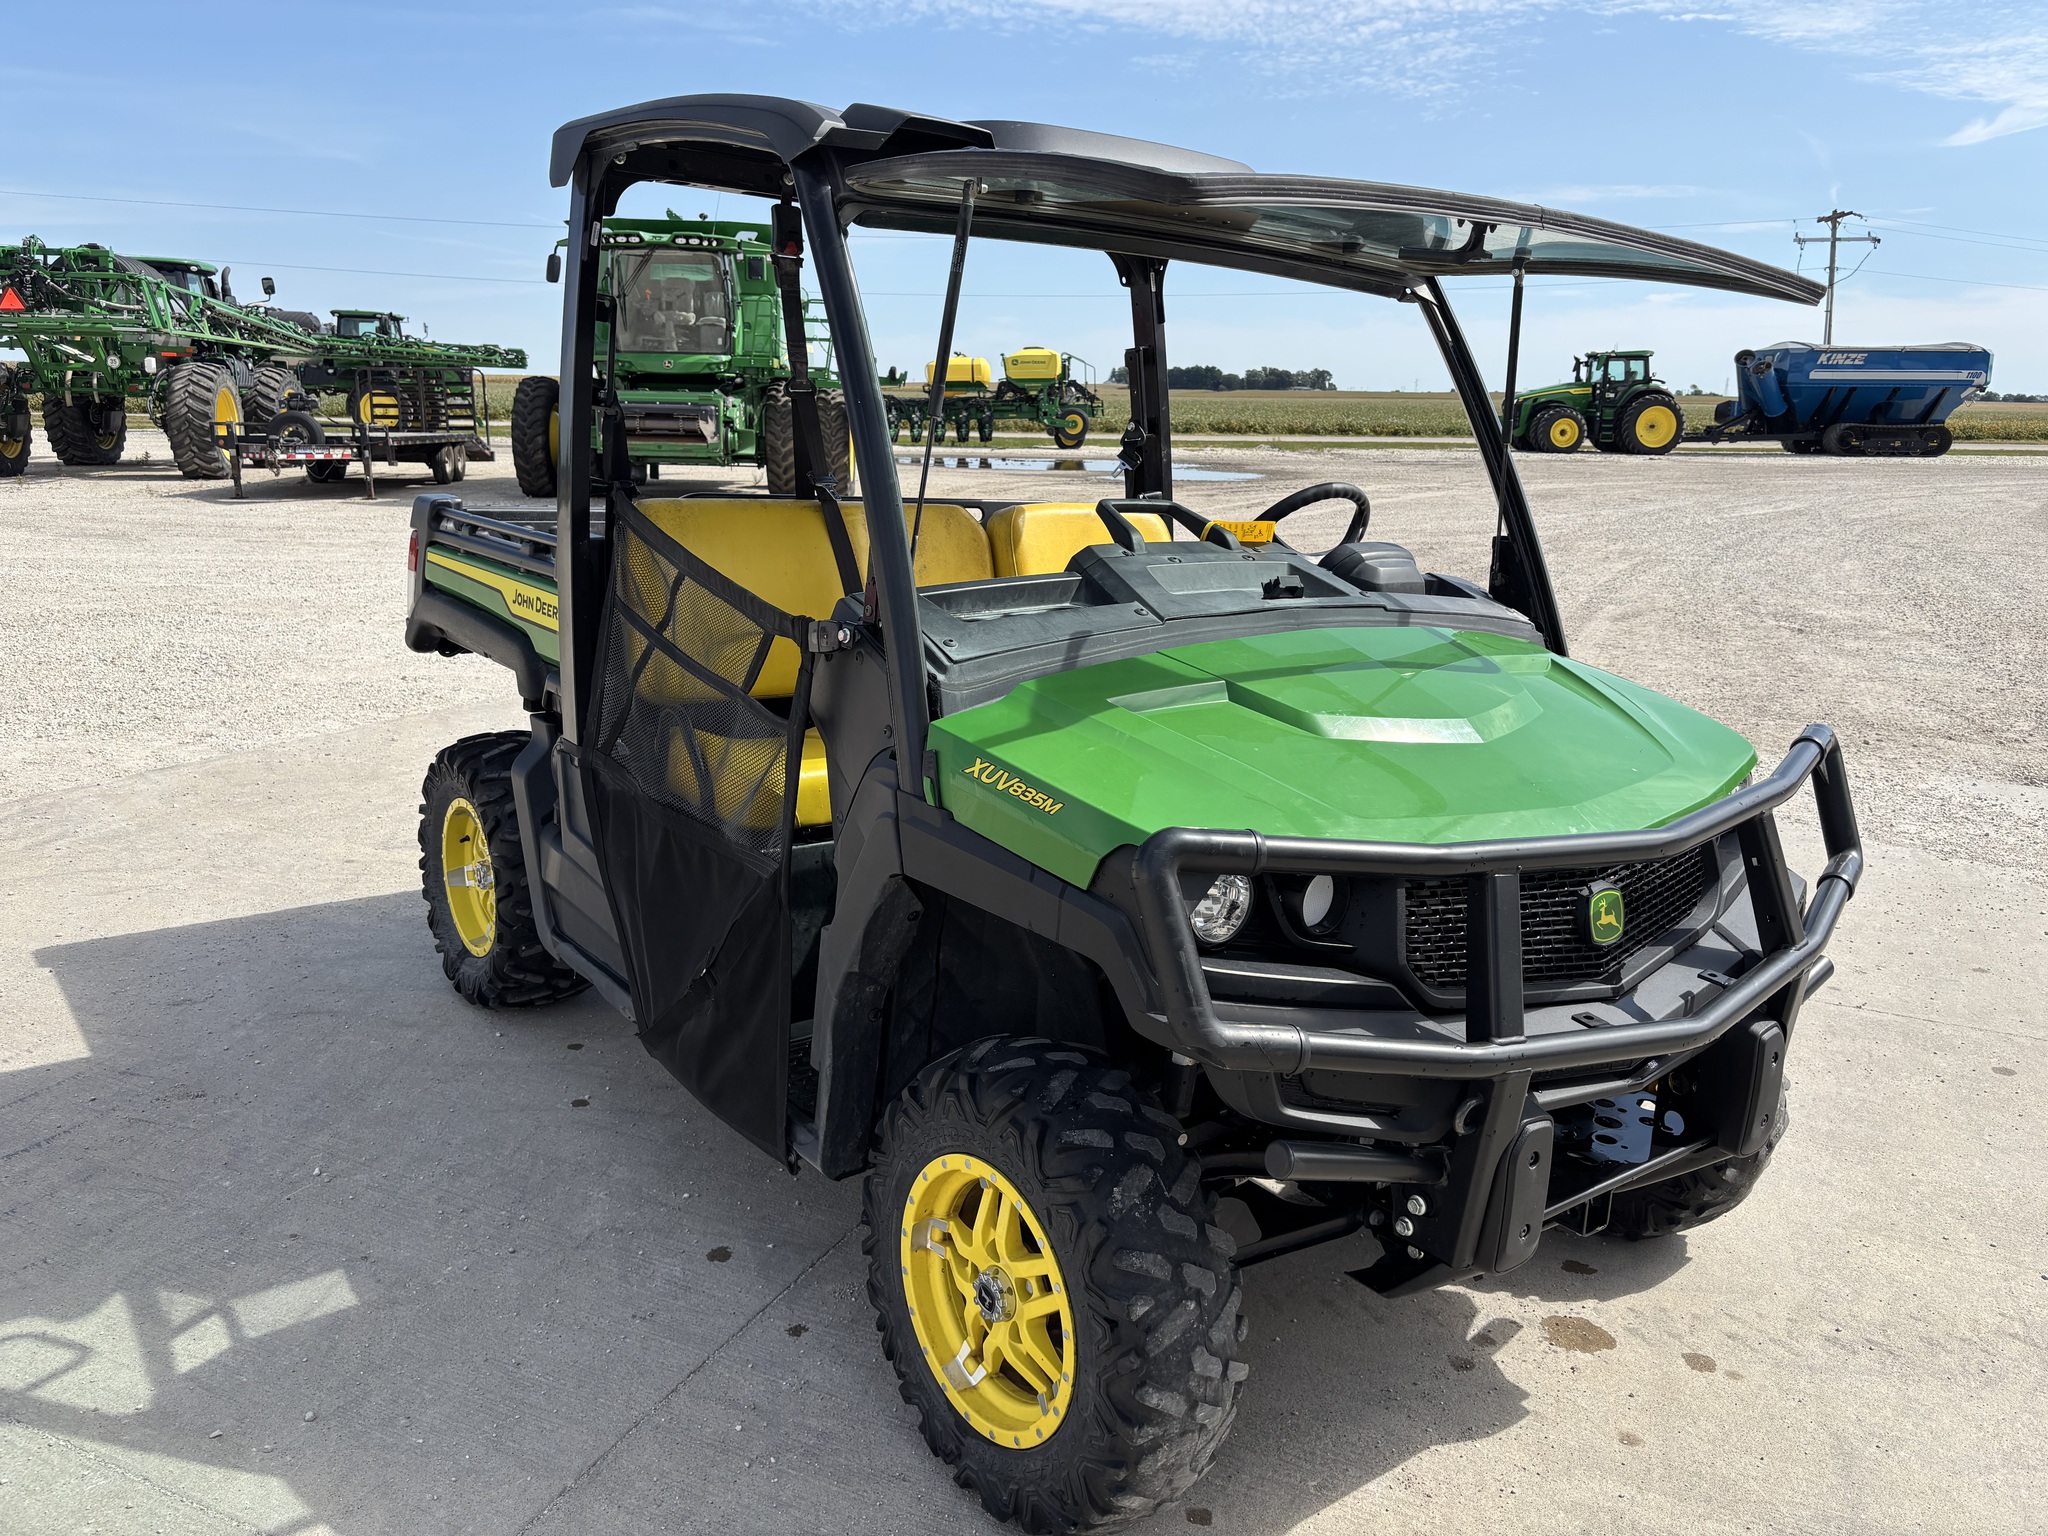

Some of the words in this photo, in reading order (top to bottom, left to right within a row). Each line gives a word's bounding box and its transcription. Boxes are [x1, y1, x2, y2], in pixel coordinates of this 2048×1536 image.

[1816, 353, 1869, 365] KINZE
[512, 589, 534, 611] JOHN
[536, 596, 559, 620] DEER
[962, 756, 1065, 816] XUV835M
